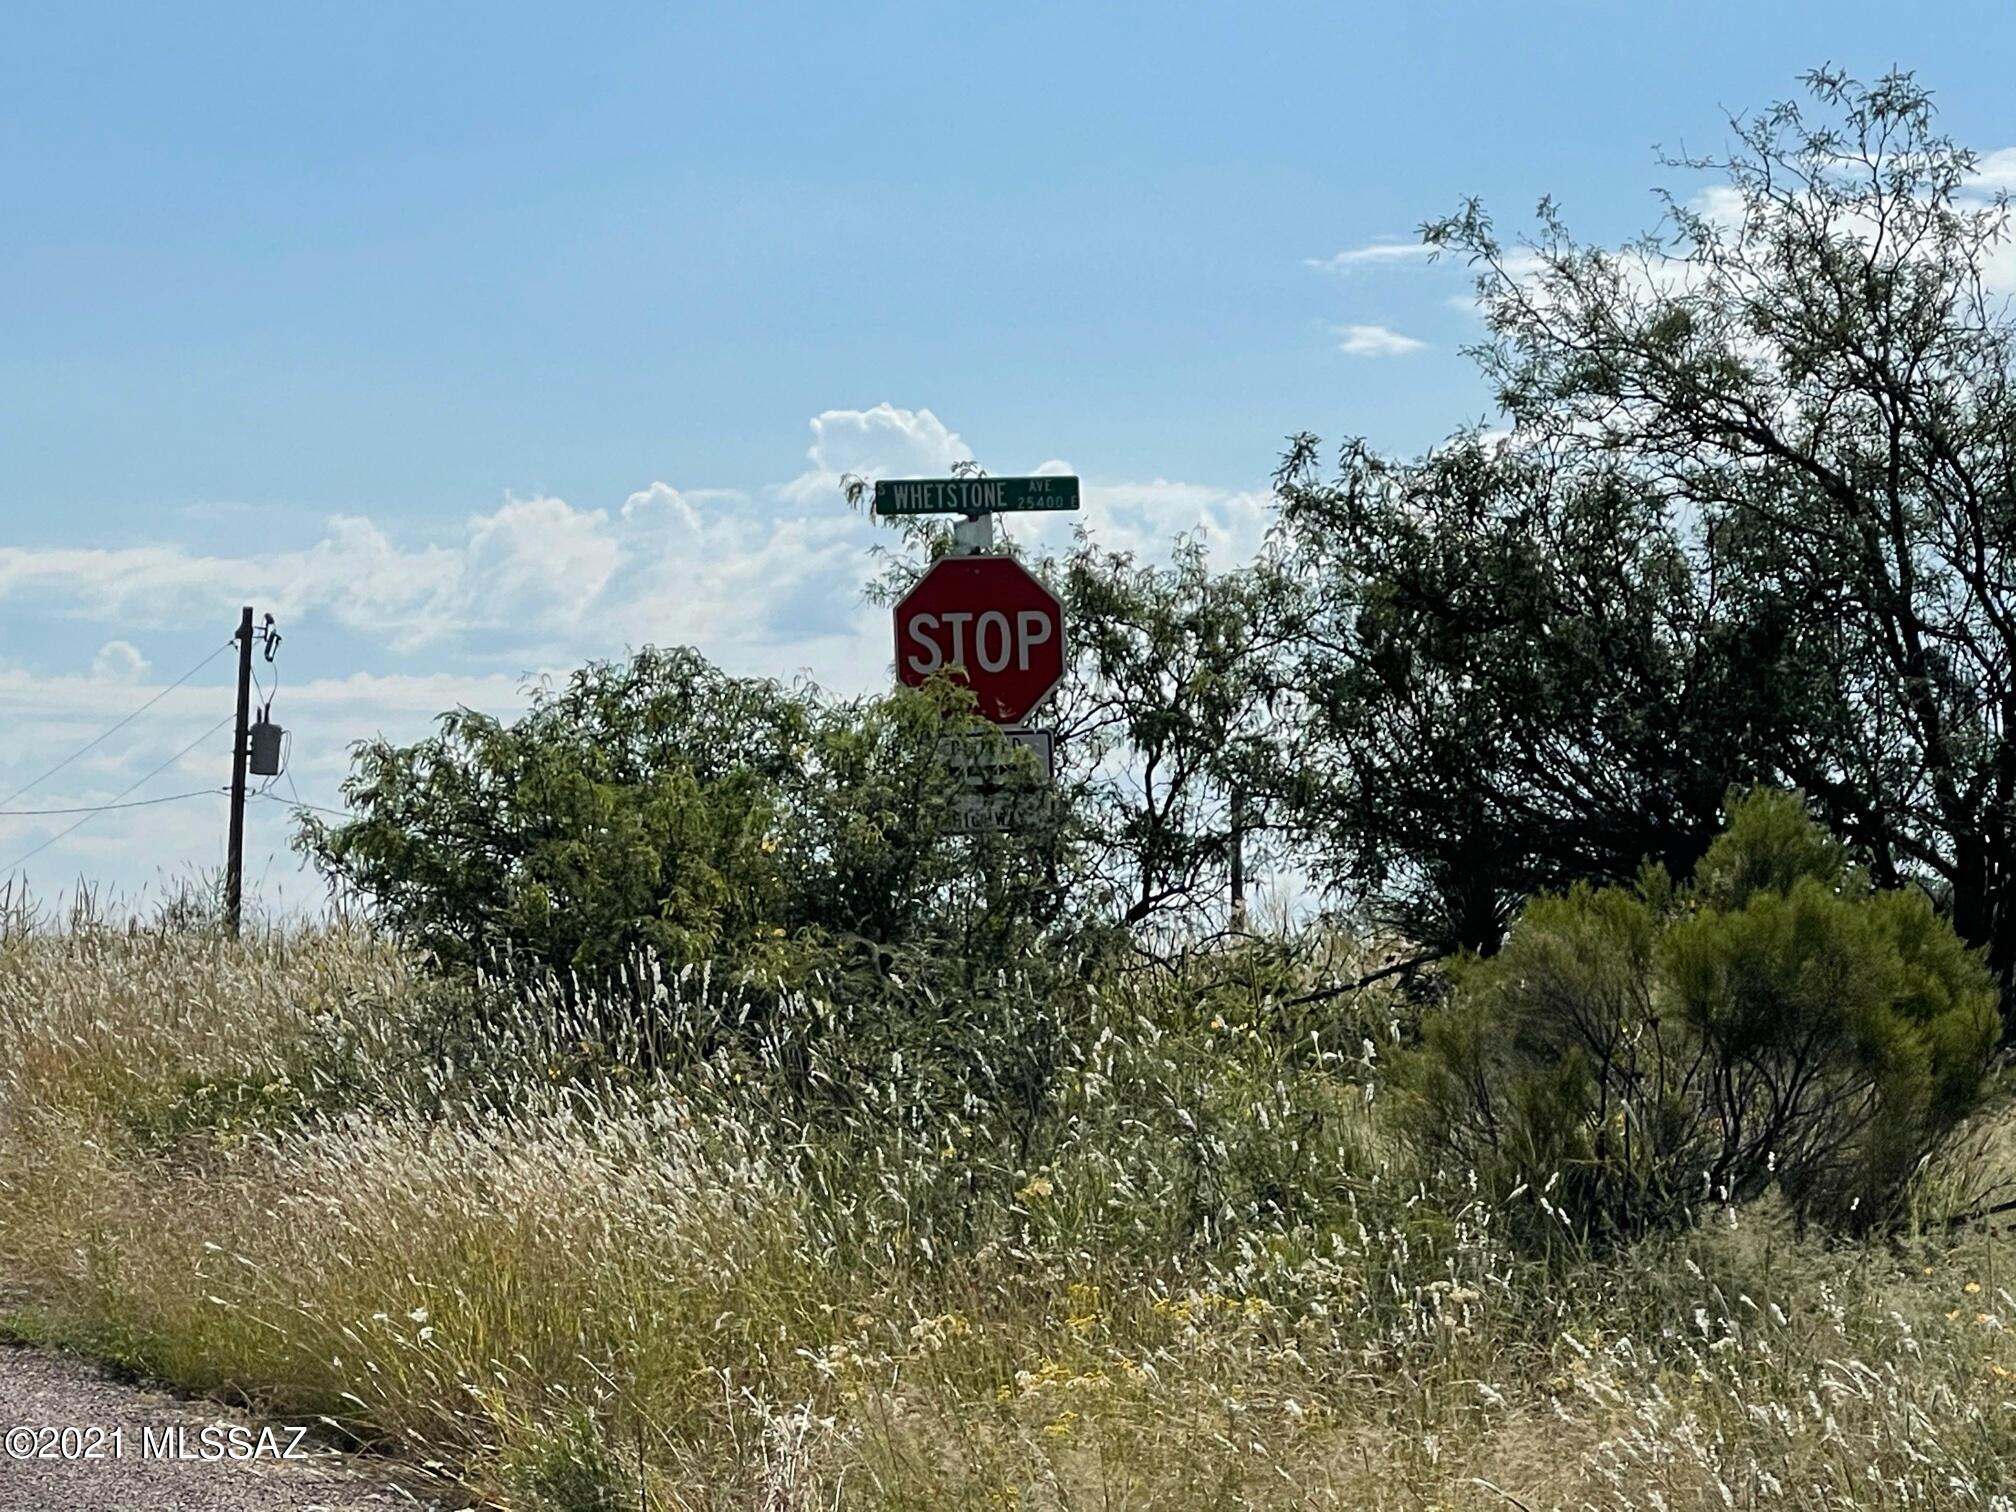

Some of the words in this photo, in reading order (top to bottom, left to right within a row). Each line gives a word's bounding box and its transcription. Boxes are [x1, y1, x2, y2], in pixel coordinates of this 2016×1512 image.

[878, 482, 886, 496] S
[893, 482, 1007, 510] WHETSTONE
[1028, 479, 1052, 492] AVE
[1017, 495, 1064, 510] 25400
[1071, 495, 1078, 508] E
[908, 610, 1052, 675] STOP
